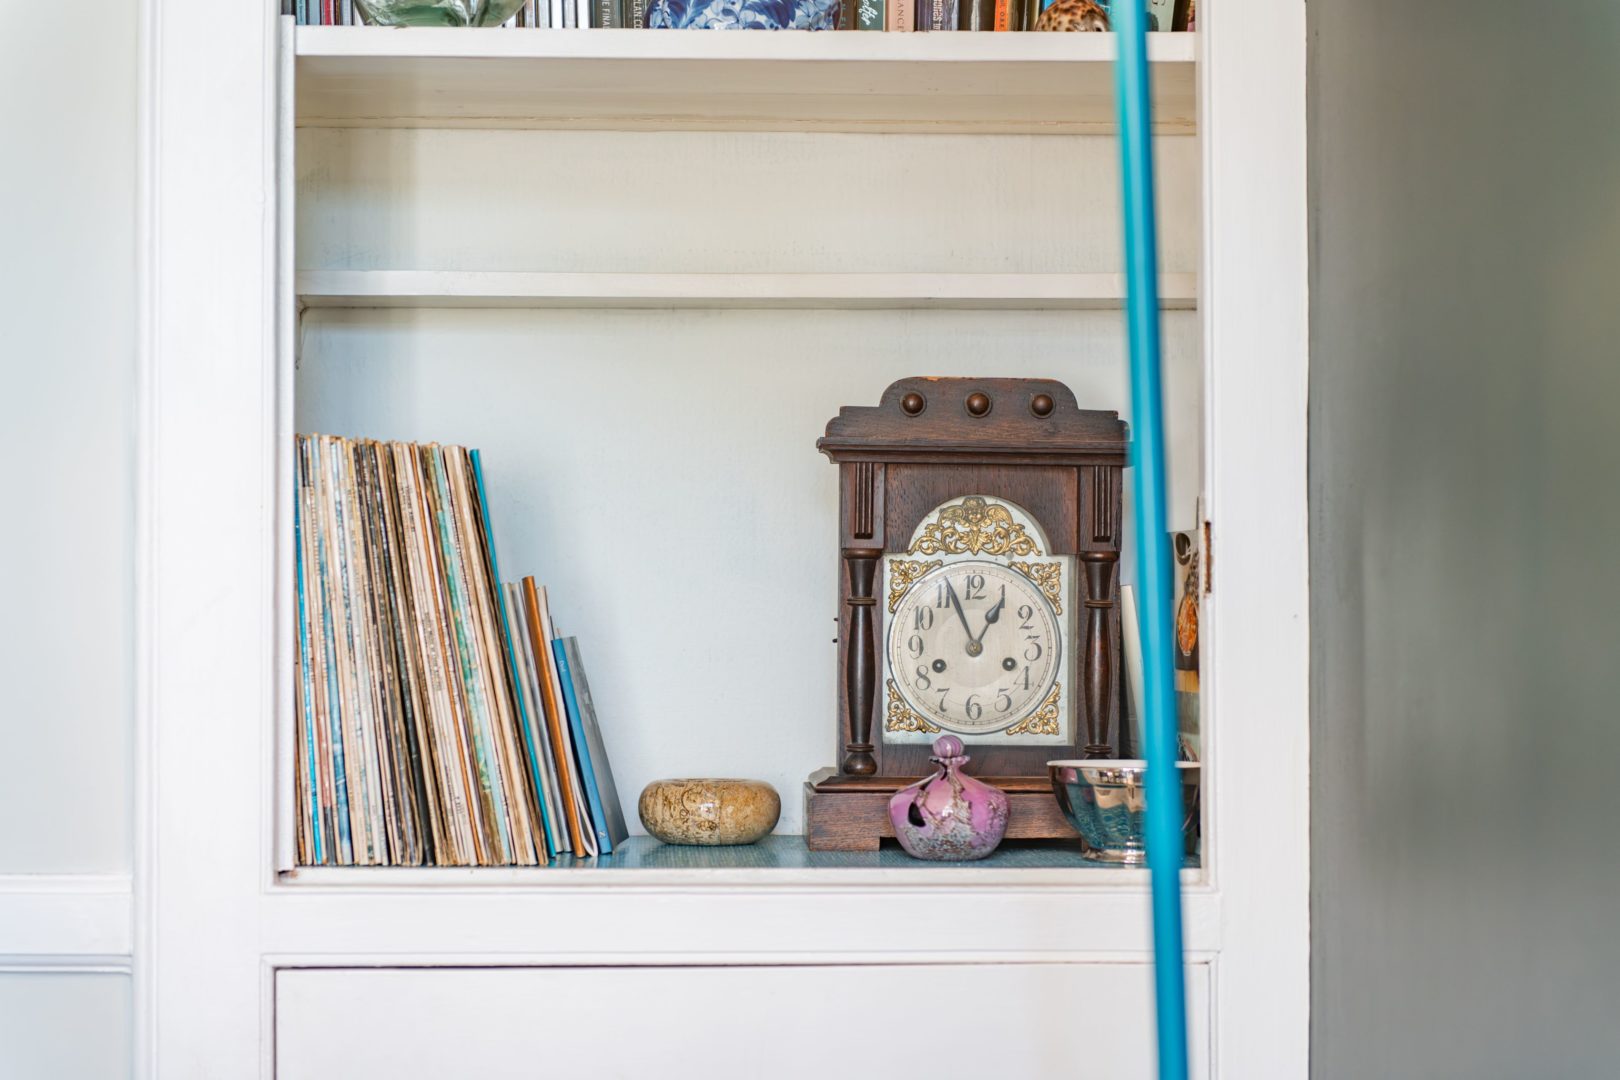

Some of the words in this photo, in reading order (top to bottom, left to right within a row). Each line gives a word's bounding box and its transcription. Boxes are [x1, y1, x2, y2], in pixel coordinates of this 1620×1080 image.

[936, 583, 951, 609] 11
[964, 575, 987, 601] 12
[998, 584, 1006, 608] 1
[912, 605, 934, 631] 10
[1017, 604, 1035, 630] 2
[908, 634, 924, 660] 9
[1023, 635, 1043, 662] 3
[915, 665, 931, 691] 8
[1013, 665, 1035, 691] 4
[937, 688, 951, 713] 7
[965, 693, 983, 721] 6
[994, 688, 1012, 713] 5
